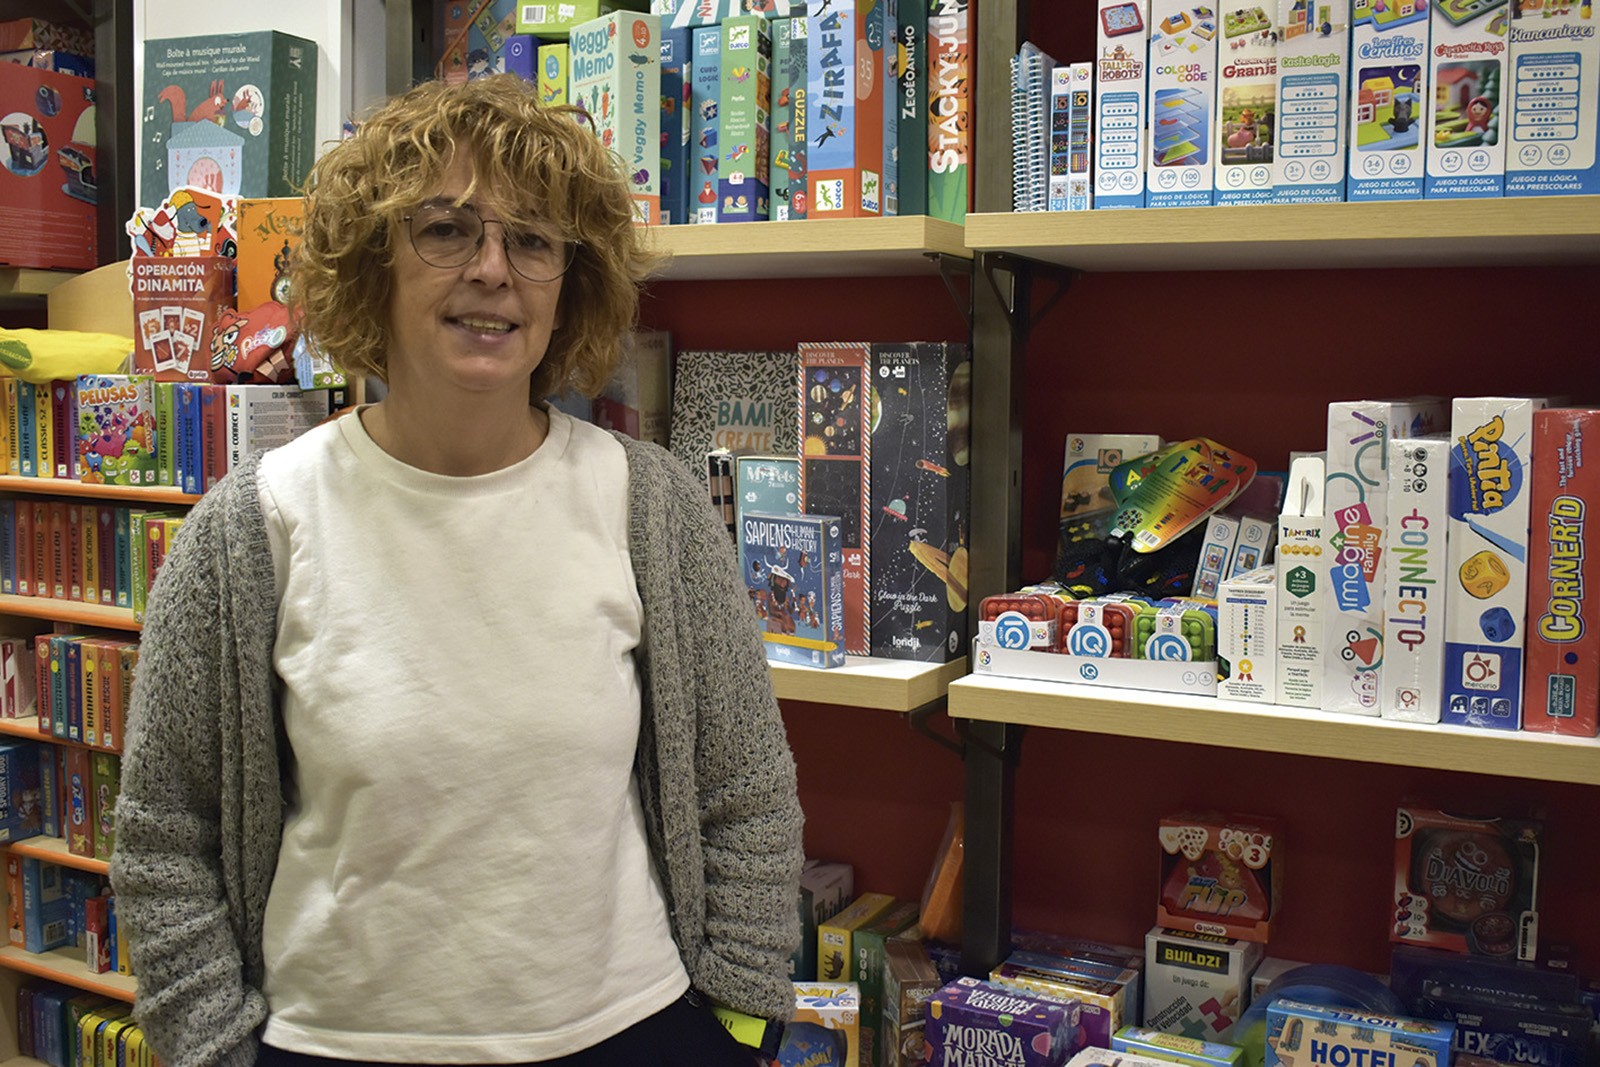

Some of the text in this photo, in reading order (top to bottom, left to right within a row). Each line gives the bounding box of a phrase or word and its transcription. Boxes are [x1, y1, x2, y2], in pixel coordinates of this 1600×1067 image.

[1372, 35, 1415, 47] Los Tres
[1510, 23, 1595, 43] Blancanieves
[570, 27, 610, 56] Veggy
[1434, 41, 1505, 58] Caperucita Roja
[167, 44, 246, 58] Boîte à musique murale
[1358, 43, 1424, 60] Cerditos
[574, 53, 614, 82] Memo
[819, 11, 845, 122] ZIRAFA
[1102, 61, 1133, 73] TALLER
[1281, 55, 1311, 68] Castle
[1311, 53, 1340, 68] Logix
[903, 25, 916, 119] ZEGÉOANIMO
[1102, 69, 1139, 80] ROBOTS
[1156, 63, 1201, 75] COLOUR
[1177, 71, 1207, 83] CODE
[931, 0, 960, 174] STACKY JUN
[634, 71, 646, 163] Veggy Memo
[795, 89, 805, 142] GUZZLE
[1523, 149, 1537, 157] 4-7
[1395, 158, 1405, 166] 48
[1553, 174, 1577, 182] LÓGICA
[1449, 185, 1499, 193] PREESCOLARES
[1528, 183, 1582, 191] PREESCOLARES
[862, 198, 879, 211] DJECO
[136, 262, 205, 276] OPERACIÓN
[137, 278, 205, 292] DINAMITA
[79, 384, 138, 408] PELUSAS
[40, 409, 46, 420] 52
[717, 401, 773, 427] BAM!
[715, 429, 771, 451] CREATE
[1557, 438, 1565, 449] and
[1574, 429, 1582, 457] matching
[1099, 450, 1122, 466] IQ
[1404, 479, 1412, 493] 1-10
[745, 521, 815, 548] SAPIENS HUMAN
[1283, 527, 1321, 539] TANTRIX
[792, 538, 817, 553] HISTORY
[1362, 532, 1377, 574] Family
[843, 569, 861, 580] Dark
[1295, 571, 1307, 579] +3
[1538, 496, 1585, 642] CORNER'D
[1390, 508, 1437, 651] CONNECTO
[878, 590, 938, 602] Glow in the Dark
[830, 592, 843, 631] SAPIENS
[893, 600, 922, 613] Puzzle
[1075, 630, 1103, 653] IQ
[1154, 640, 1183, 660] IQ
[1082, 665, 1097, 678] IQ
[1465, 680, 1498, 691] mercurio
[86, 671, 94, 728] BANANAS
[1425, 854, 1509, 896] DIAVOLO
[1182, 885, 1248, 917] FLIP
[1412, 927, 1424, 936] 2-6
[1165, 948, 1220, 969] BUILDZI
[1173, 975, 1181, 983] Un
[1181, 976, 1199, 987] juego
[1146, 995, 1188, 1028] Construcción
[1160, 1002, 1193, 1030] Velocidad
[942, 1023, 1026, 1062] MORADA
[1455, 1028, 1491, 1055] LEX
